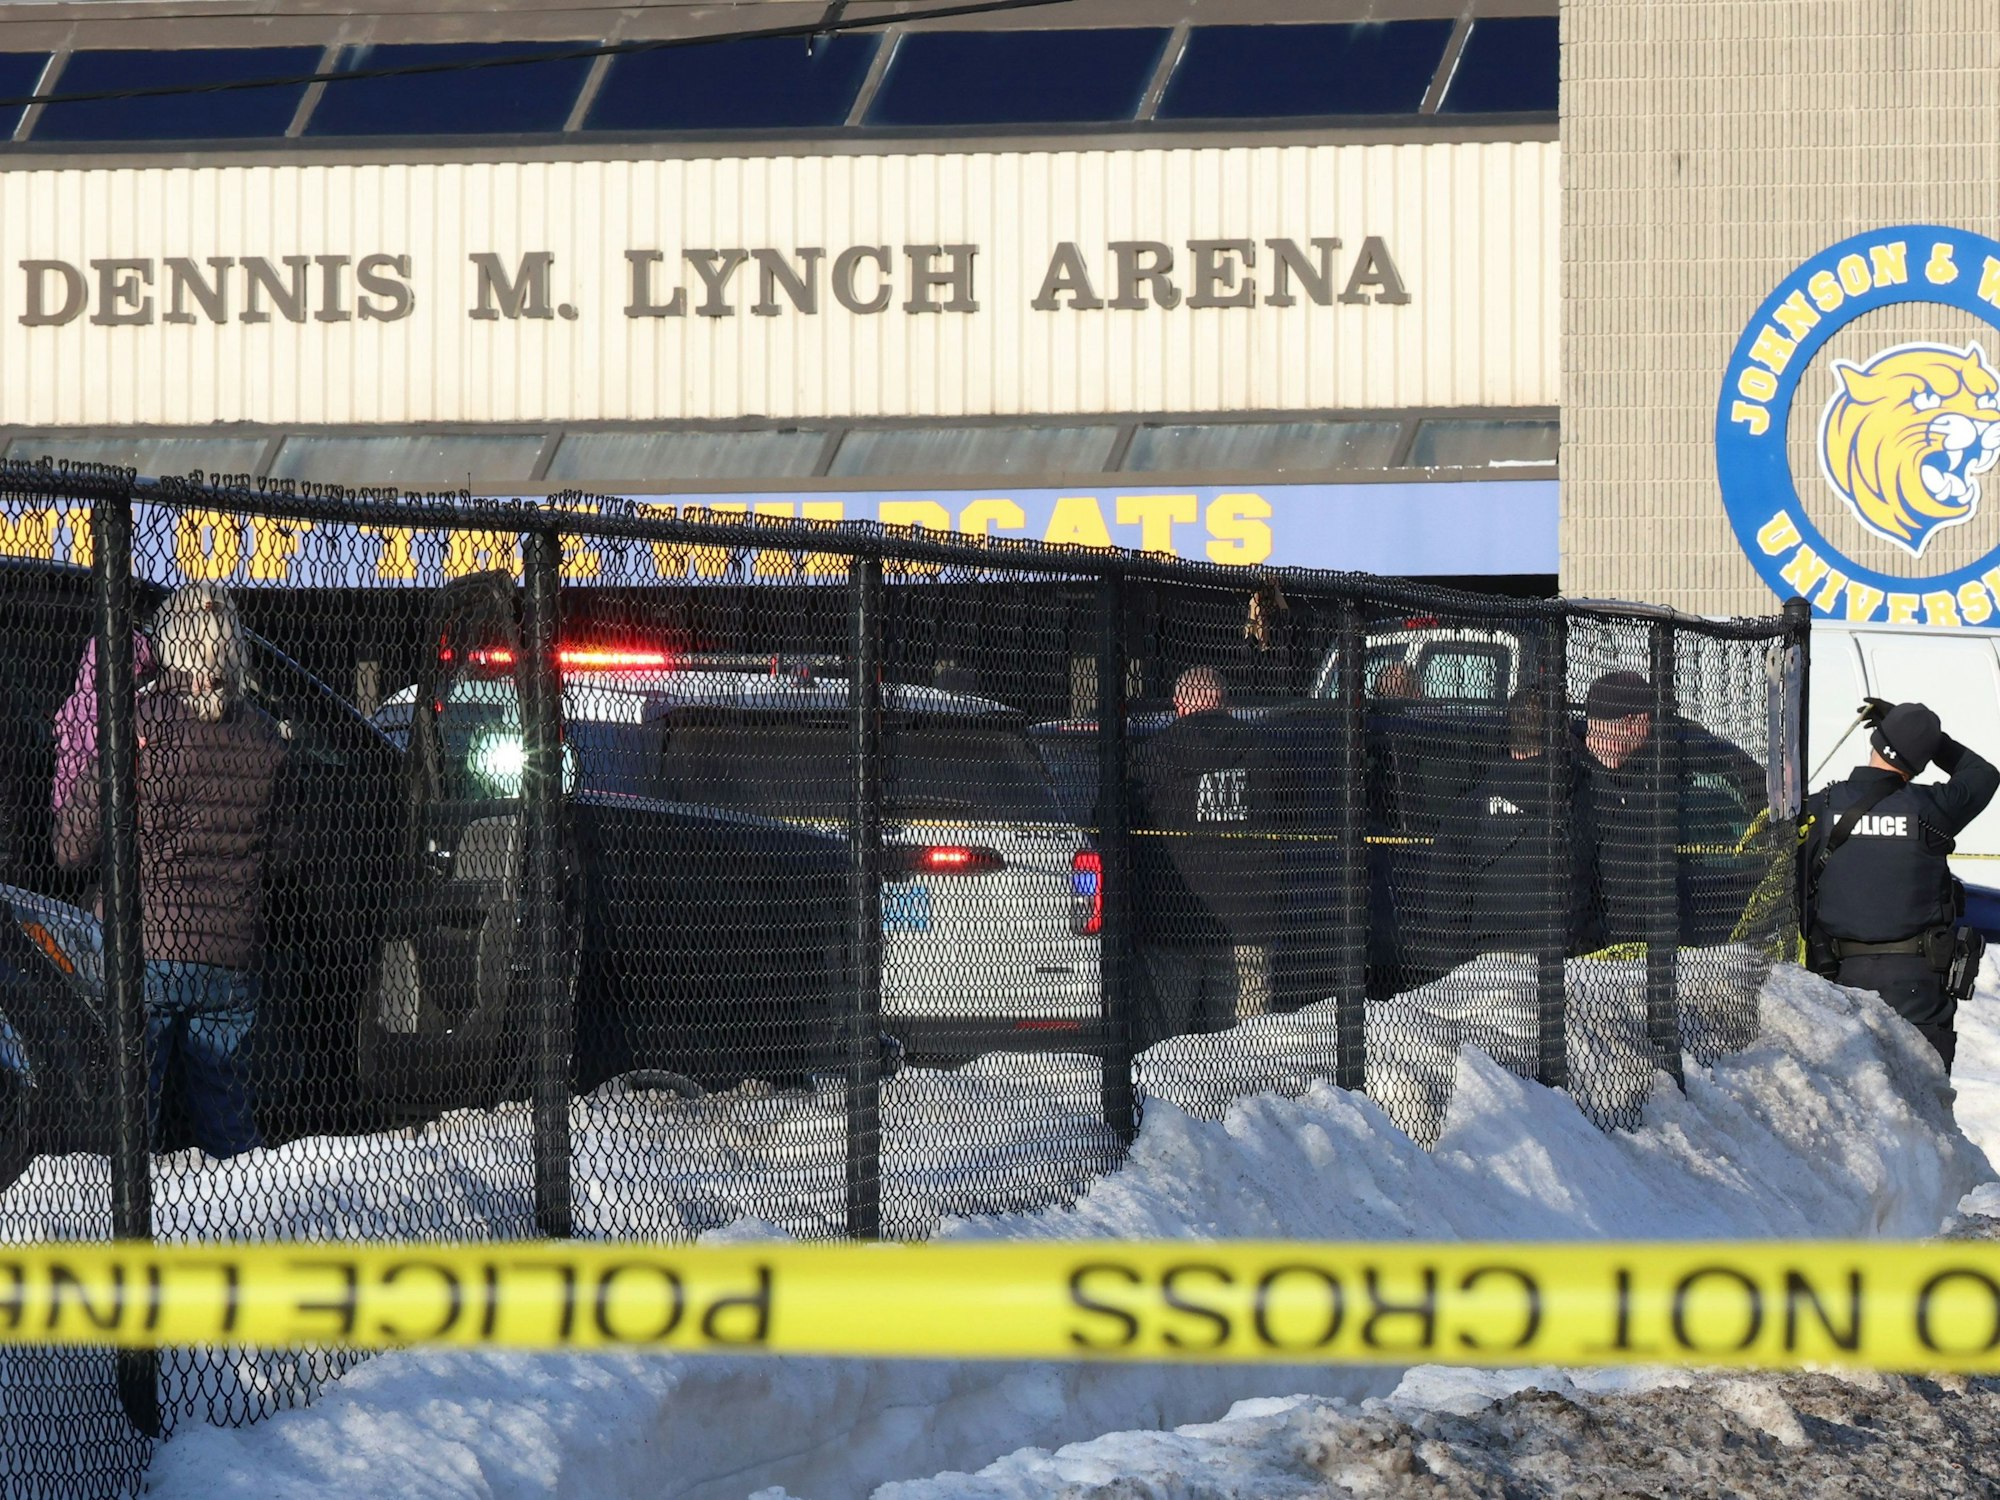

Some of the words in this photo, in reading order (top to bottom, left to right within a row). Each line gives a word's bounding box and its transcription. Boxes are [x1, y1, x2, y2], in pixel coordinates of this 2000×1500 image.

[18, 253, 415, 326] DENNIS
[468, 251, 579, 321] M.
[623, 244, 980, 319] LYNCH
[1031, 236, 1412, 311] ARENA
[1731, 241, 1908, 436] JOHNSON
[1925, 243, 1959, 285] &
[284, 1258, 775, 1346] POLICE
[1066, 1260, 1543, 1352] CROSS
[1586, 1266, 1864, 1354] NOT
